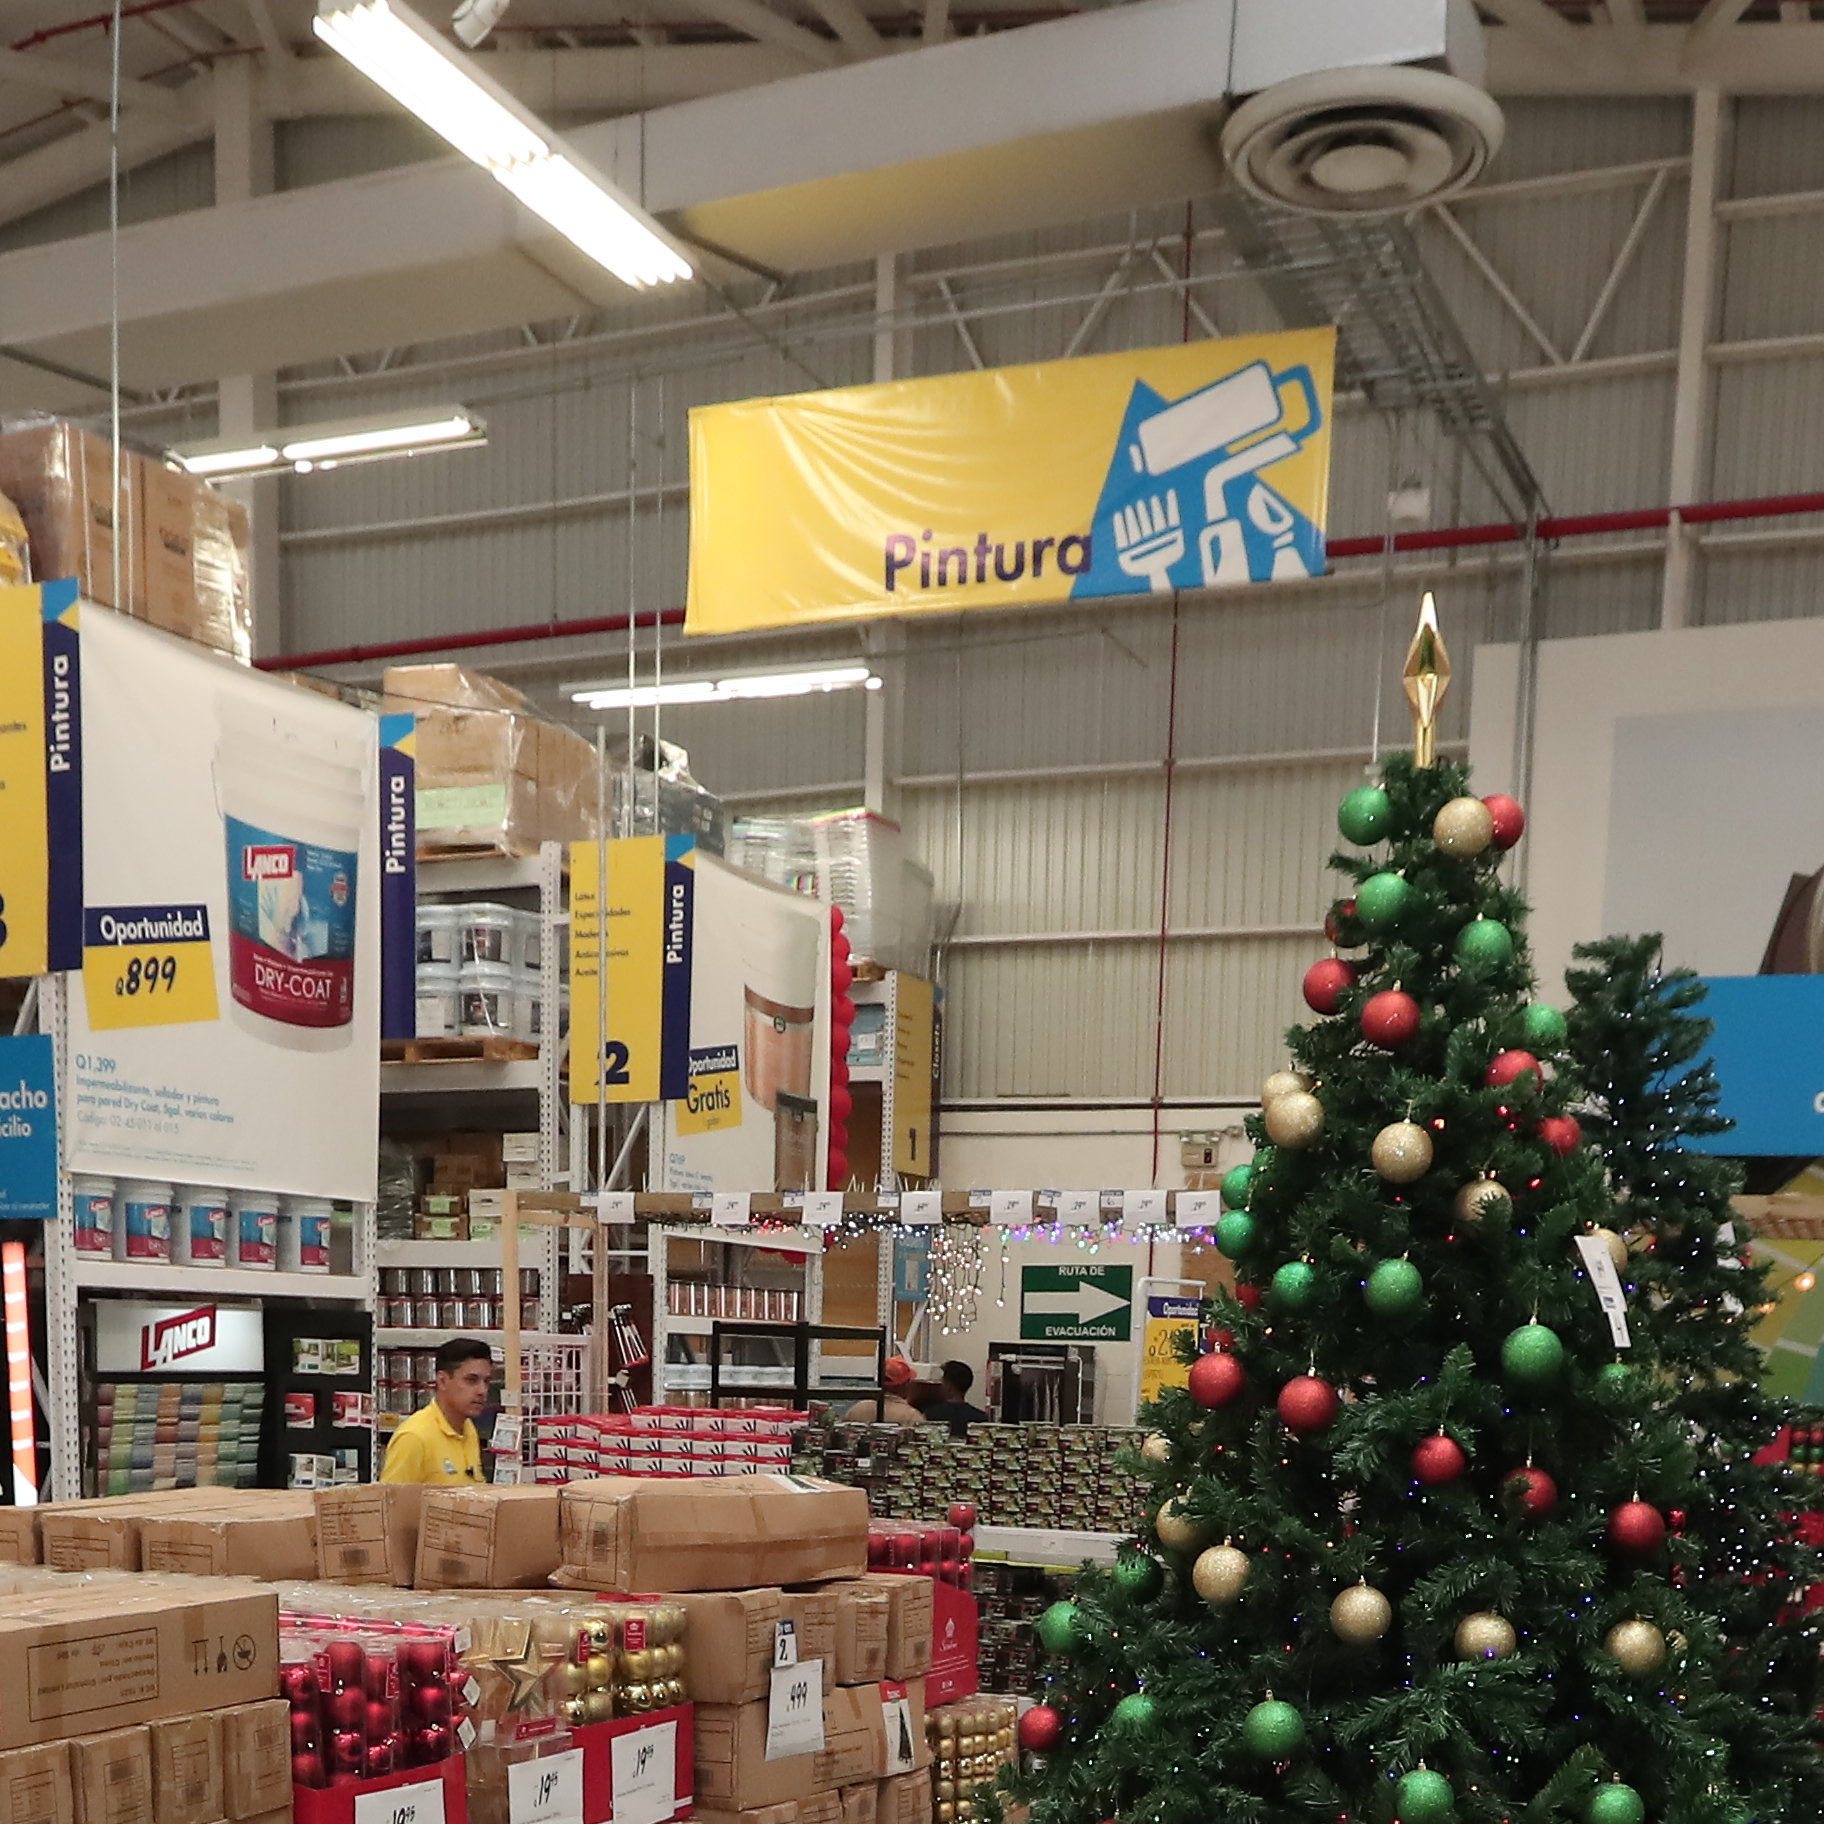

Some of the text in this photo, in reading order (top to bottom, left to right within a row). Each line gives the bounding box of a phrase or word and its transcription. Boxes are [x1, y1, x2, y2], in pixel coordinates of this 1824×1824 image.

[884, 528, 1093, 593] Pintura
[50, 654, 71, 773] Pintura
[384, 775, 406, 875] Pintura
[100, 911, 204, 945] Oportunidad
[666, 884, 685, 964] Pintura
[125, 956, 178, 994] 899
[255, 964, 333, 999] DRY-COAT
[77, 1054, 117, 1074] Q1,399
[596, 1040, 630, 1086] 2
[687, 1080, 731, 1115] Gratis
[909, 1127, 917, 1161] 1
[1058, 1266, 1106, 1276] RUTA DE
[144, 1314, 214, 1371] LANCO
[1045, 1325, 1116, 1337] EVACUACIÓN
